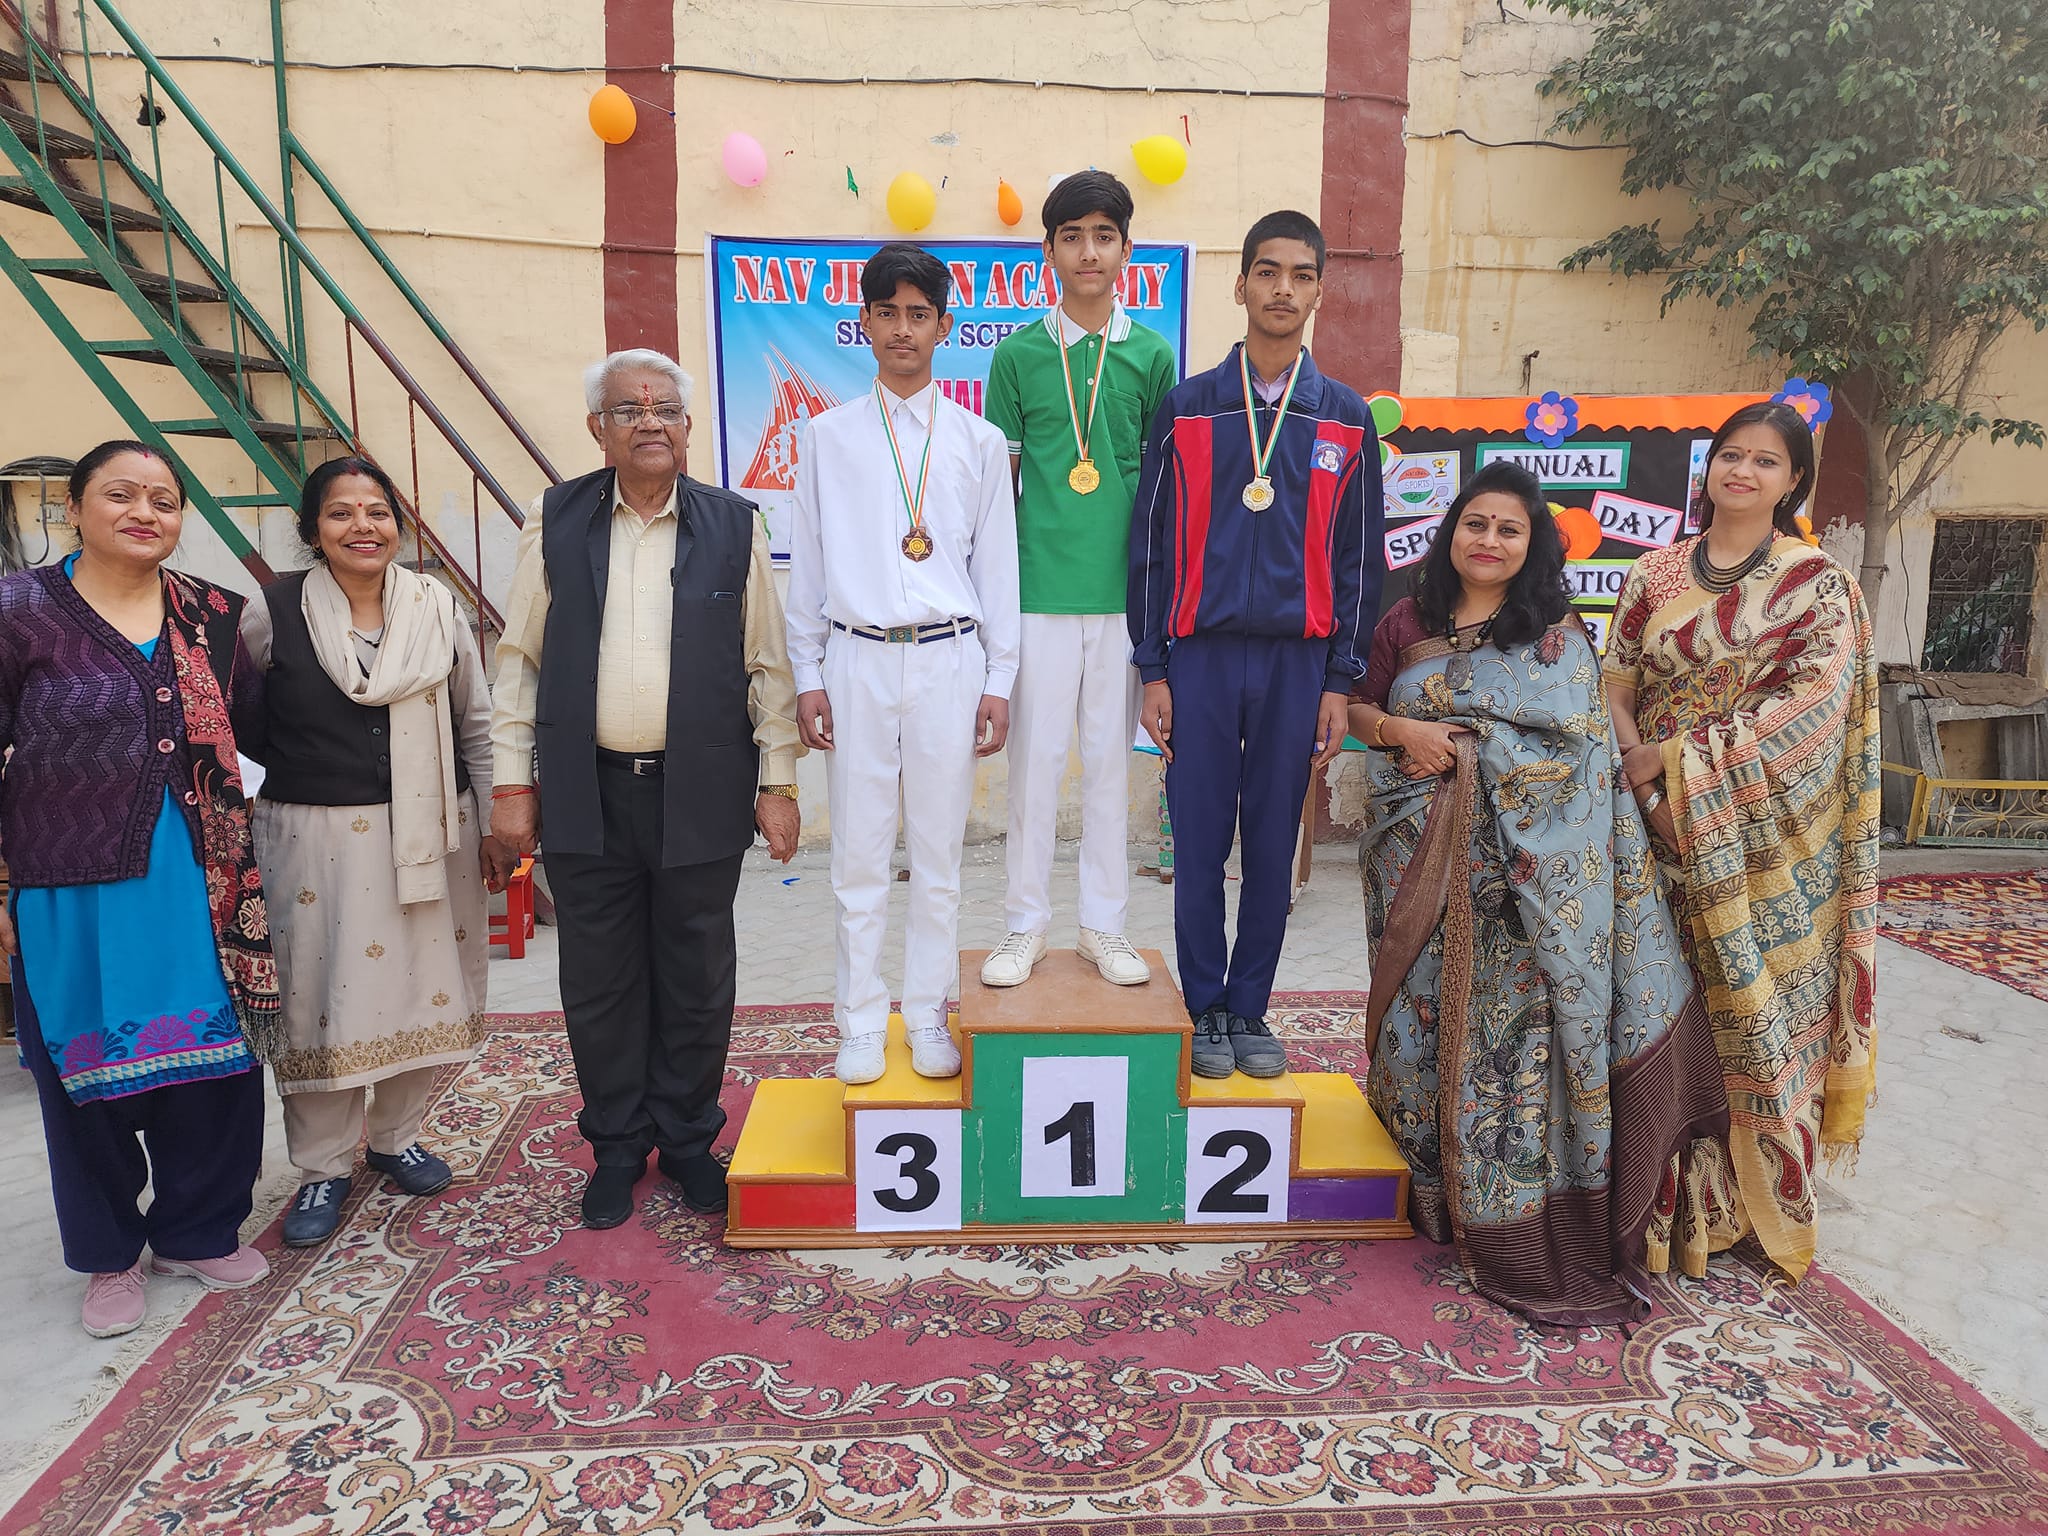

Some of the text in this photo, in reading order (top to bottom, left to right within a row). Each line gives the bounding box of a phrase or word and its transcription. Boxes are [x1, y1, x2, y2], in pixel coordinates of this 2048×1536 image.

[733, 257, 815, 302] NAV
[984, 263, 1168, 308] ACAMY
[1404, 480, 1430, 490] SPORTS
[1389, 526, 1439, 560] SPO
[1600, 504, 1673, 541] DAY
[1044, 1101, 1096, 1187] 1
[873, 1132, 940, 1213] 3
[1197, 1129, 1272, 1213] 2
